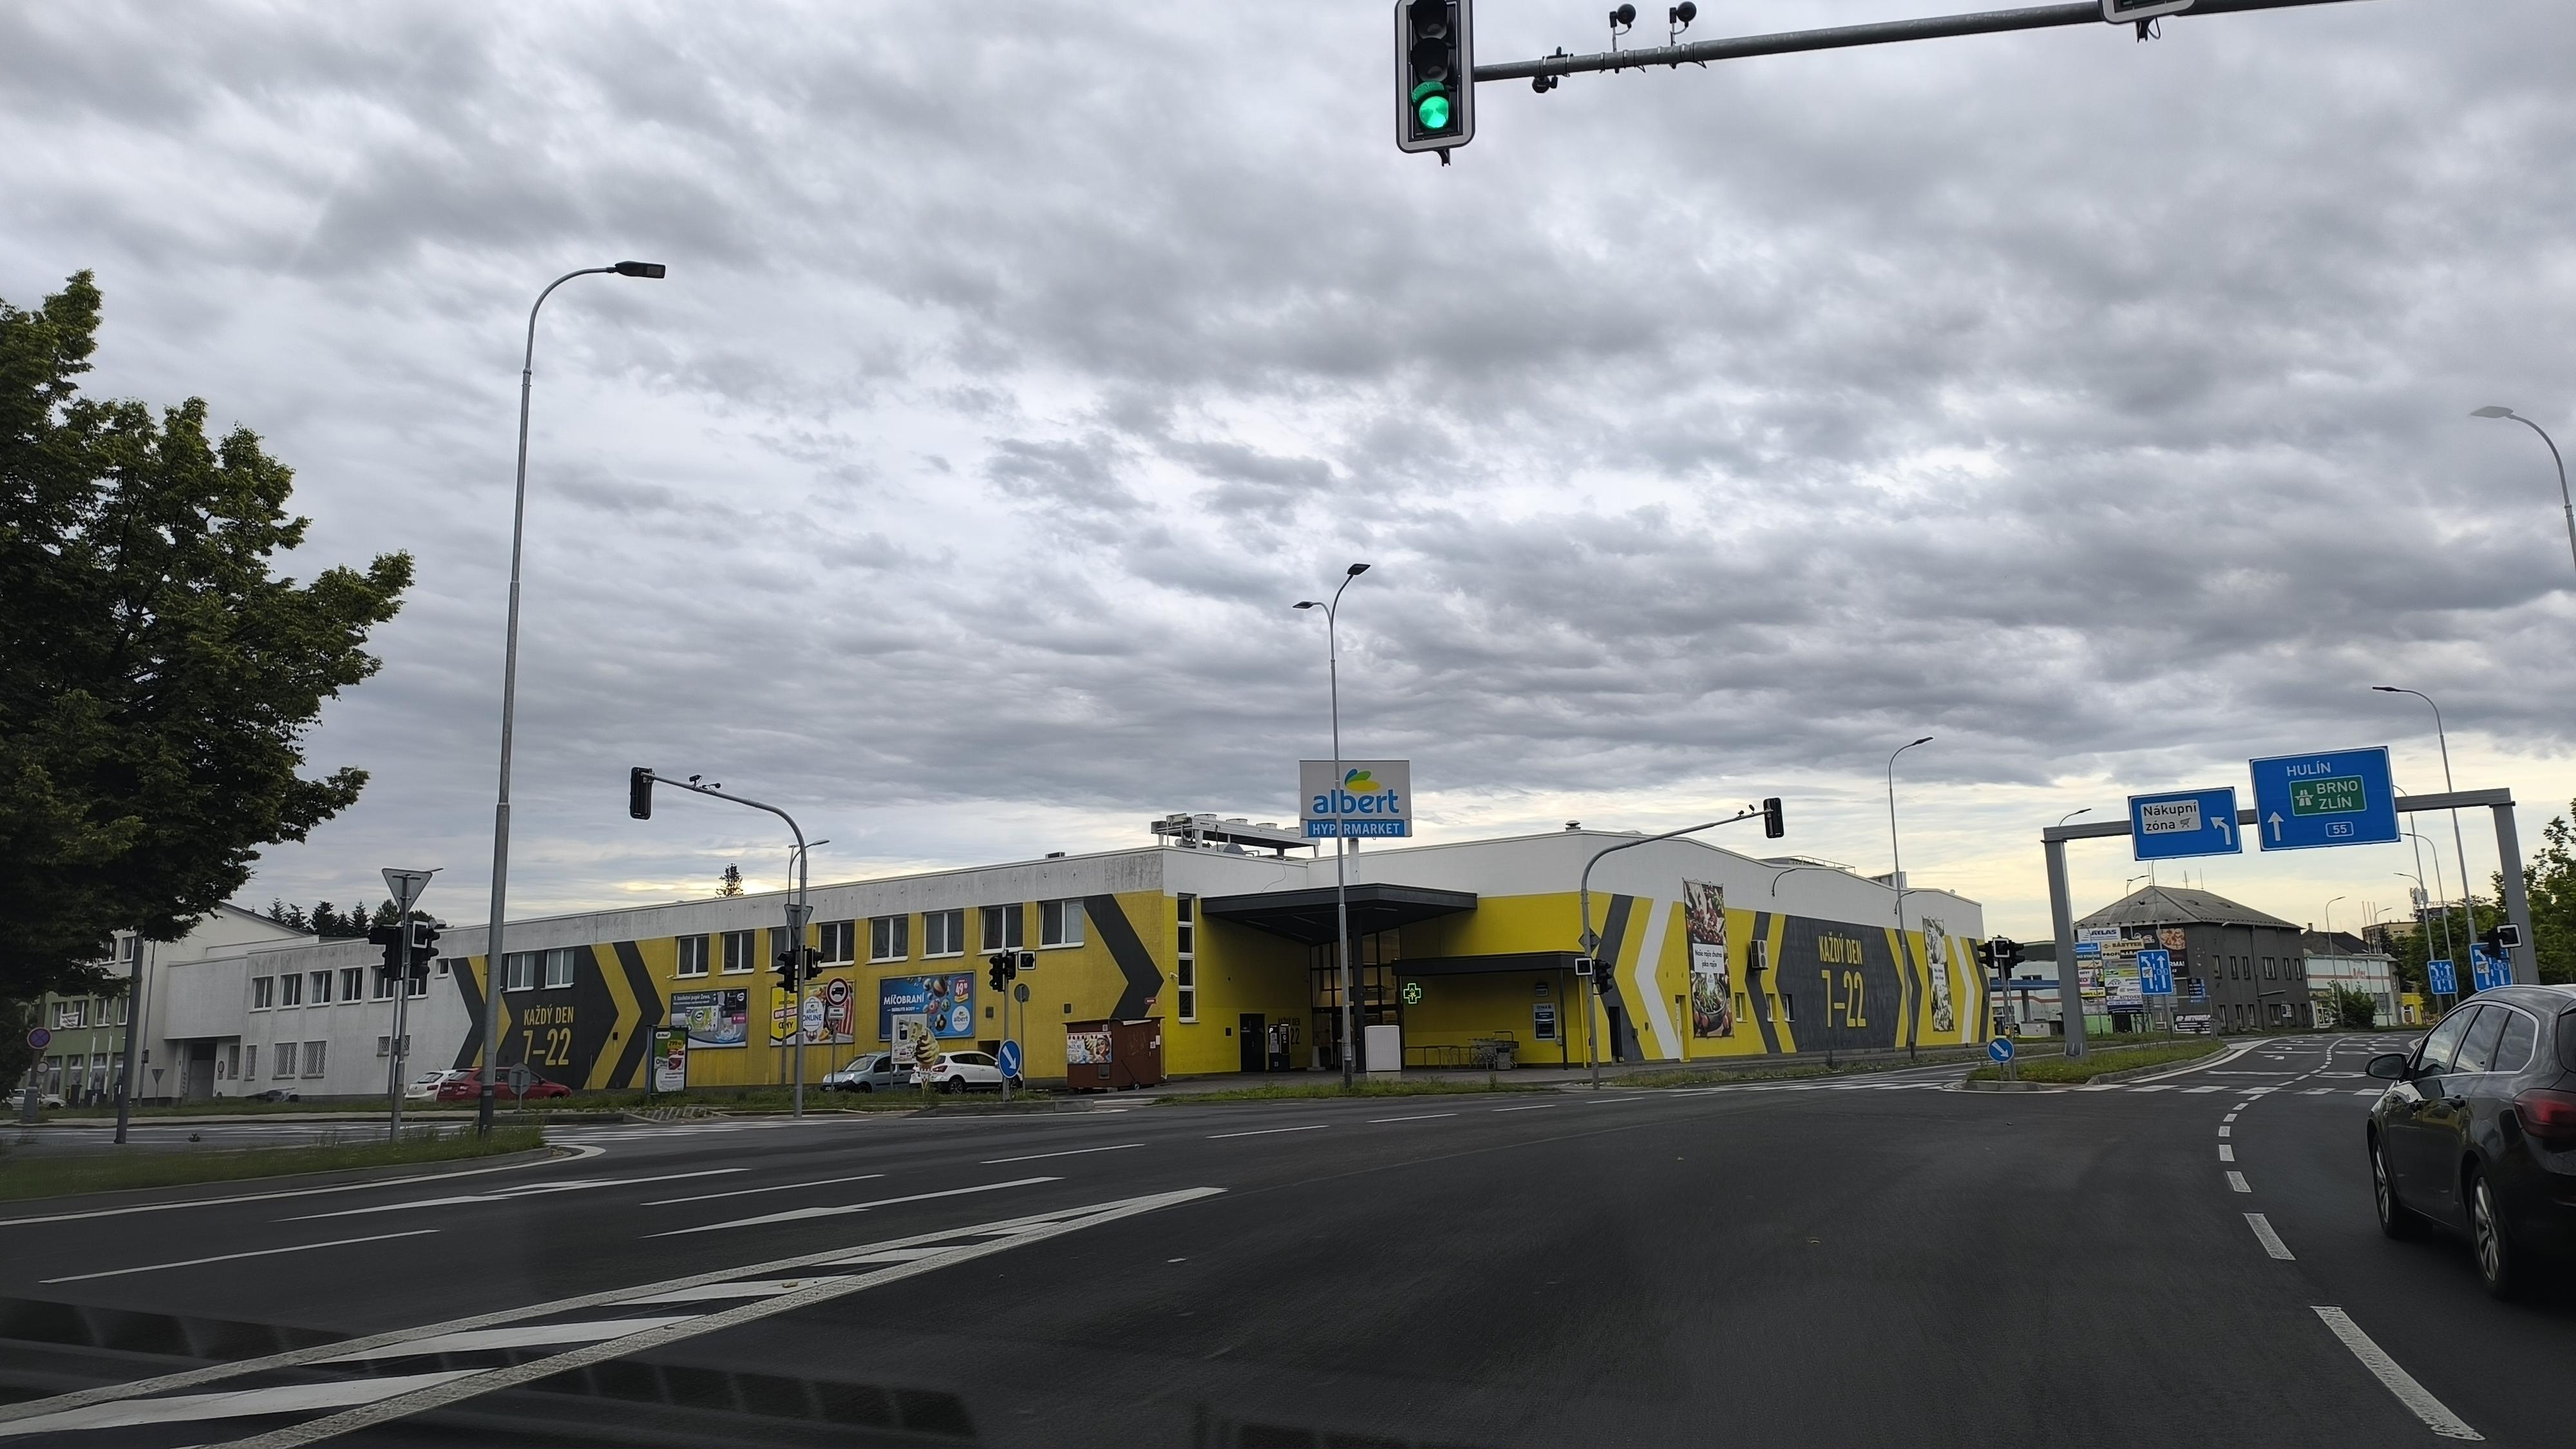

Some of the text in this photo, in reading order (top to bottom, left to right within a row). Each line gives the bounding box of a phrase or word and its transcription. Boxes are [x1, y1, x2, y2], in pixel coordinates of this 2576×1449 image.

[2286, 761, 2331, 777] HULÍN
[2316, 781, 2358, 794] BRNO
[1313, 790, 1399, 813] albert
[2318, 795, 2352, 810] ZLÍN
[2143, 802, 2197, 817] Nákupní
[1312, 824, 1400, 835] HYPRMARKET
[2145, 820, 2175, 831] zóna
[2333, 824, 2347, 834] 55
[1819, 931, 1863, 965] KAŽDÝ DEN
[956, 983, 963, 995] 49
[884, 992, 925, 1005] MÍČOBRANÍ
[524, 1003, 574, 1025] KAŽDÝ DEN
